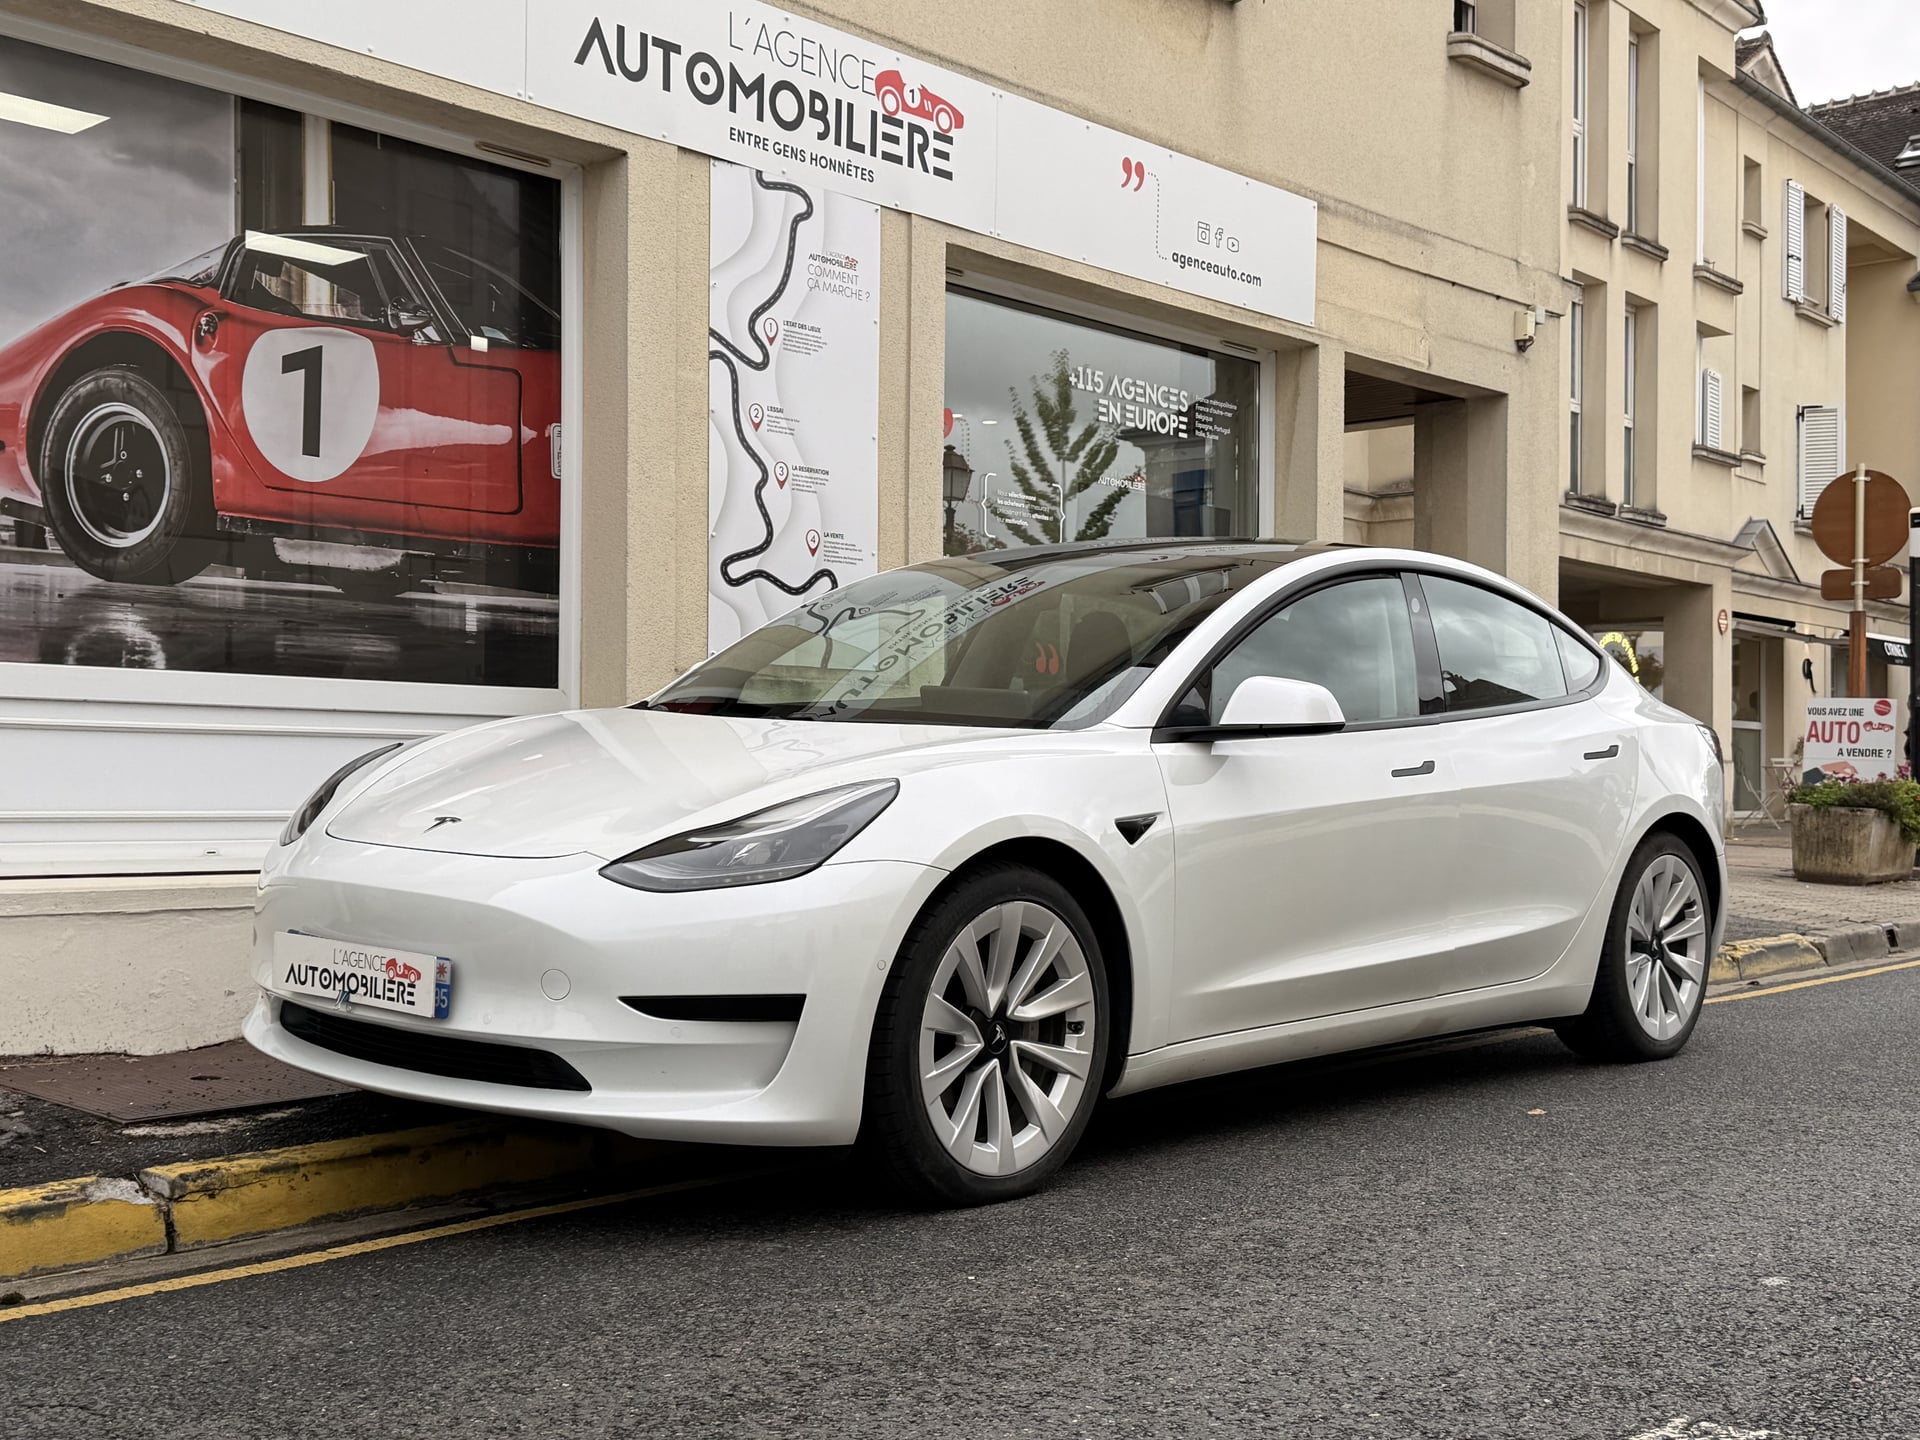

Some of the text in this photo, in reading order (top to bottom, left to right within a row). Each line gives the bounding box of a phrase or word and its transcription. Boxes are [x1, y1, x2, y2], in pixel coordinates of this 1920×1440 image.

[729, 11, 876, 98] L'AGENCE
[729, 127, 875, 183] ENTRE GENS HONNÊTES
[808, 264, 859, 286] COMMENT
[1172, 251, 1262, 287] agenceauto.com
[807, 278, 821, 292] ÇA
[823, 282, 864, 301] MARCHE
[281, 345, 325, 458] 1
[1069, 366, 1189, 413] +115 AGENCES
[754, 408, 760, 418] 2
[1099, 399, 1189, 439] EN EUROPE
[779, 466, 784, 476] 3
[810, 535, 816, 544] 4
[1807, 707, 1826, 716] VOUS
[1827, 707, 1847, 716] AVEZ
[1849, 708, 1864, 717] UNE
[1806, 720, 1860, 744] AUTO
[1837, 748, 1892, 758] A VENDRE ?
[333, 948, 387, 973] L'AGENCE
